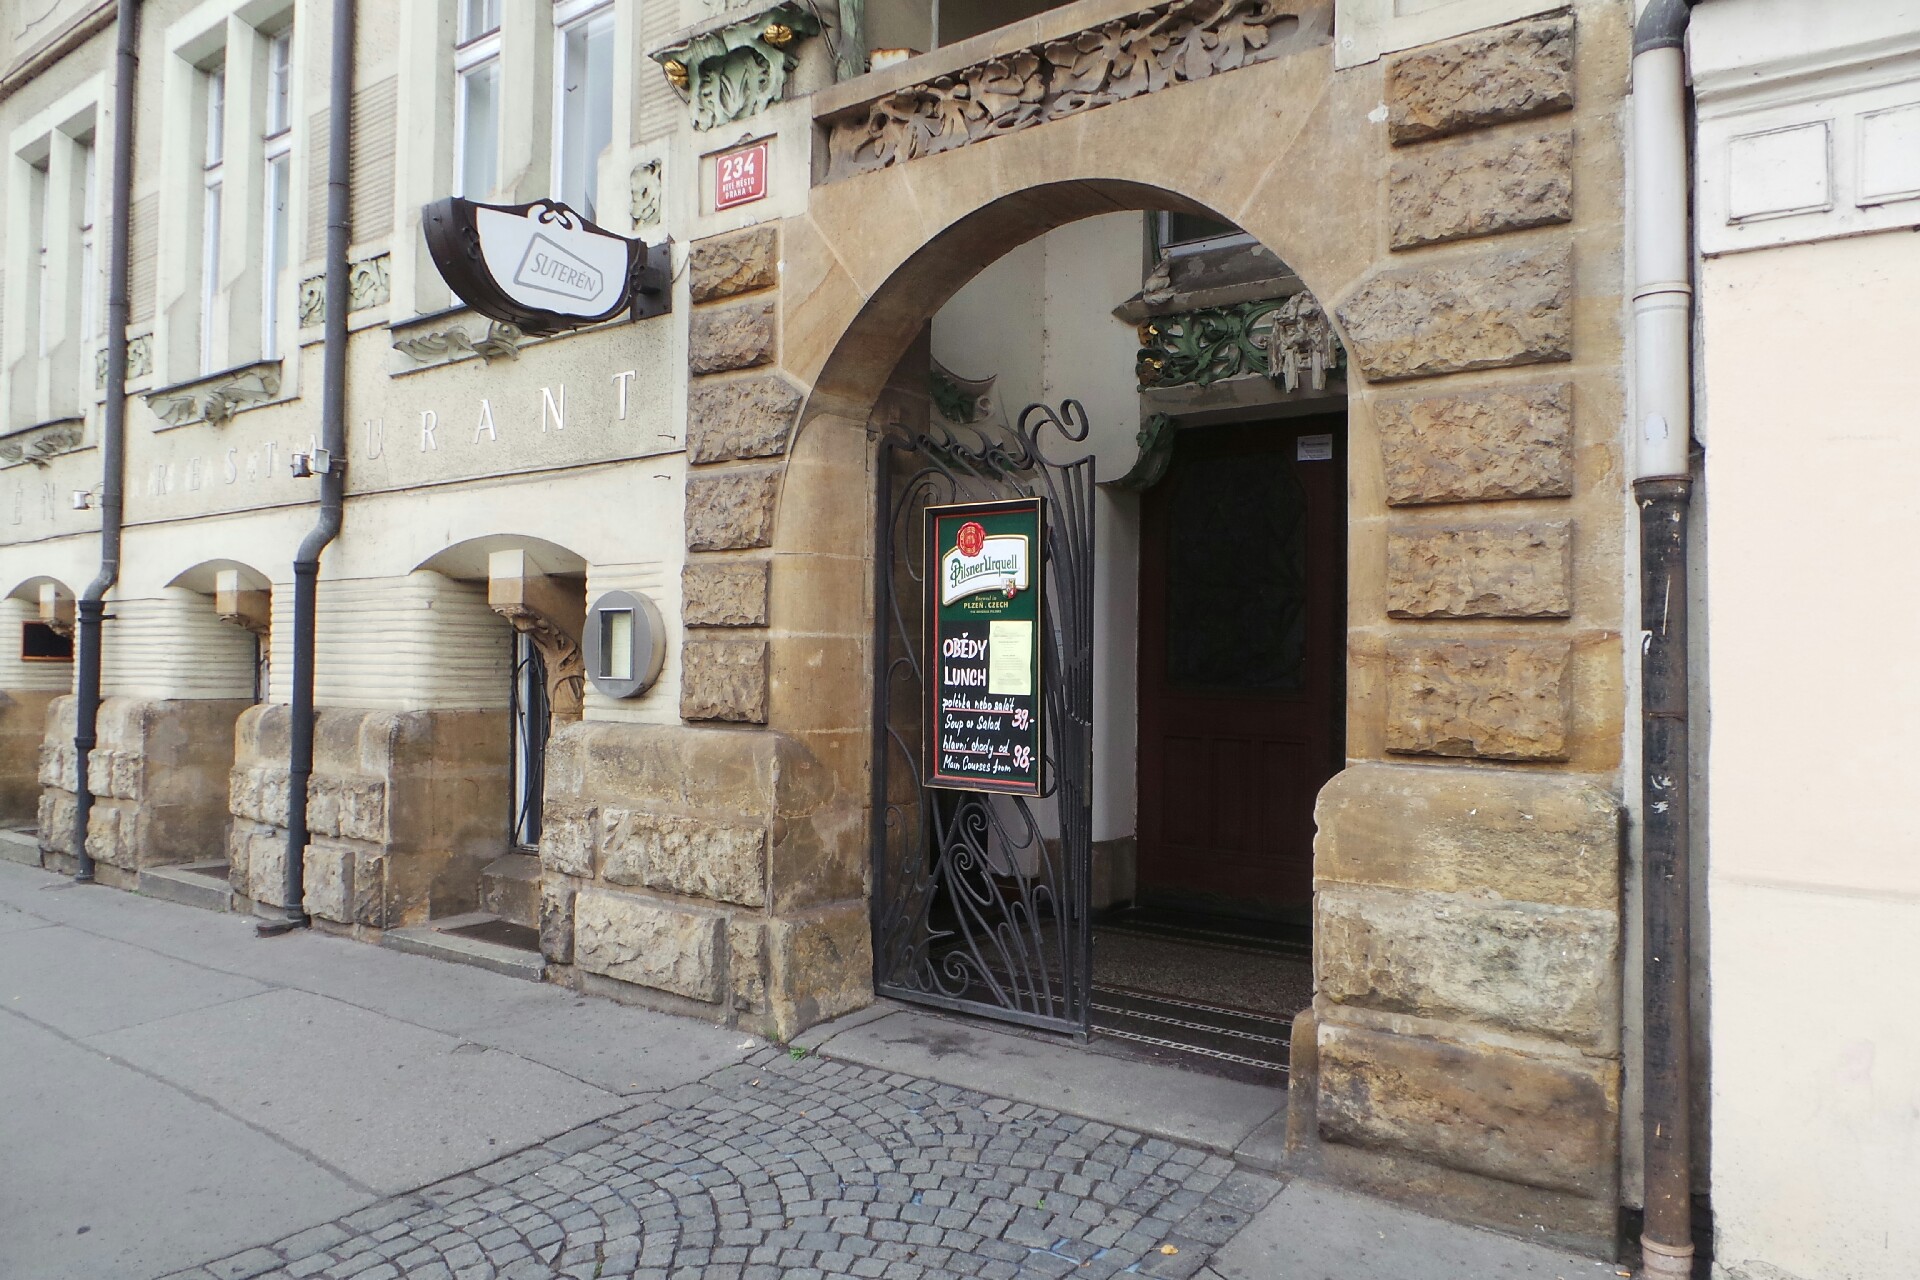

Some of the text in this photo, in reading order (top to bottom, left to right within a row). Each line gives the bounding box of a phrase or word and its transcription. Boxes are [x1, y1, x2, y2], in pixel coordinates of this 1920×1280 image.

[723, 152, 754, 182] 234
[725, 187, 747, 200] PRAHA
[531, 253, 597, 293] SUTERÉN
[950, 554, 1018, 588] Pilsner Urquell
[988, 601, 1009, 609] CZECH
[943, 632, 987, 660] OBĚDY
[944, 666, 987, 687] LUNCH
[975, 696, 993, 711] nebo
[994, 697, 1015, 712] salát
[944, 714, 1002, 737] Soup or Salad
[942, 734, 970, 752] hlavní
[998, 739, 1010, 754] od
[943, 754, 1012, 774] Main Courses from
